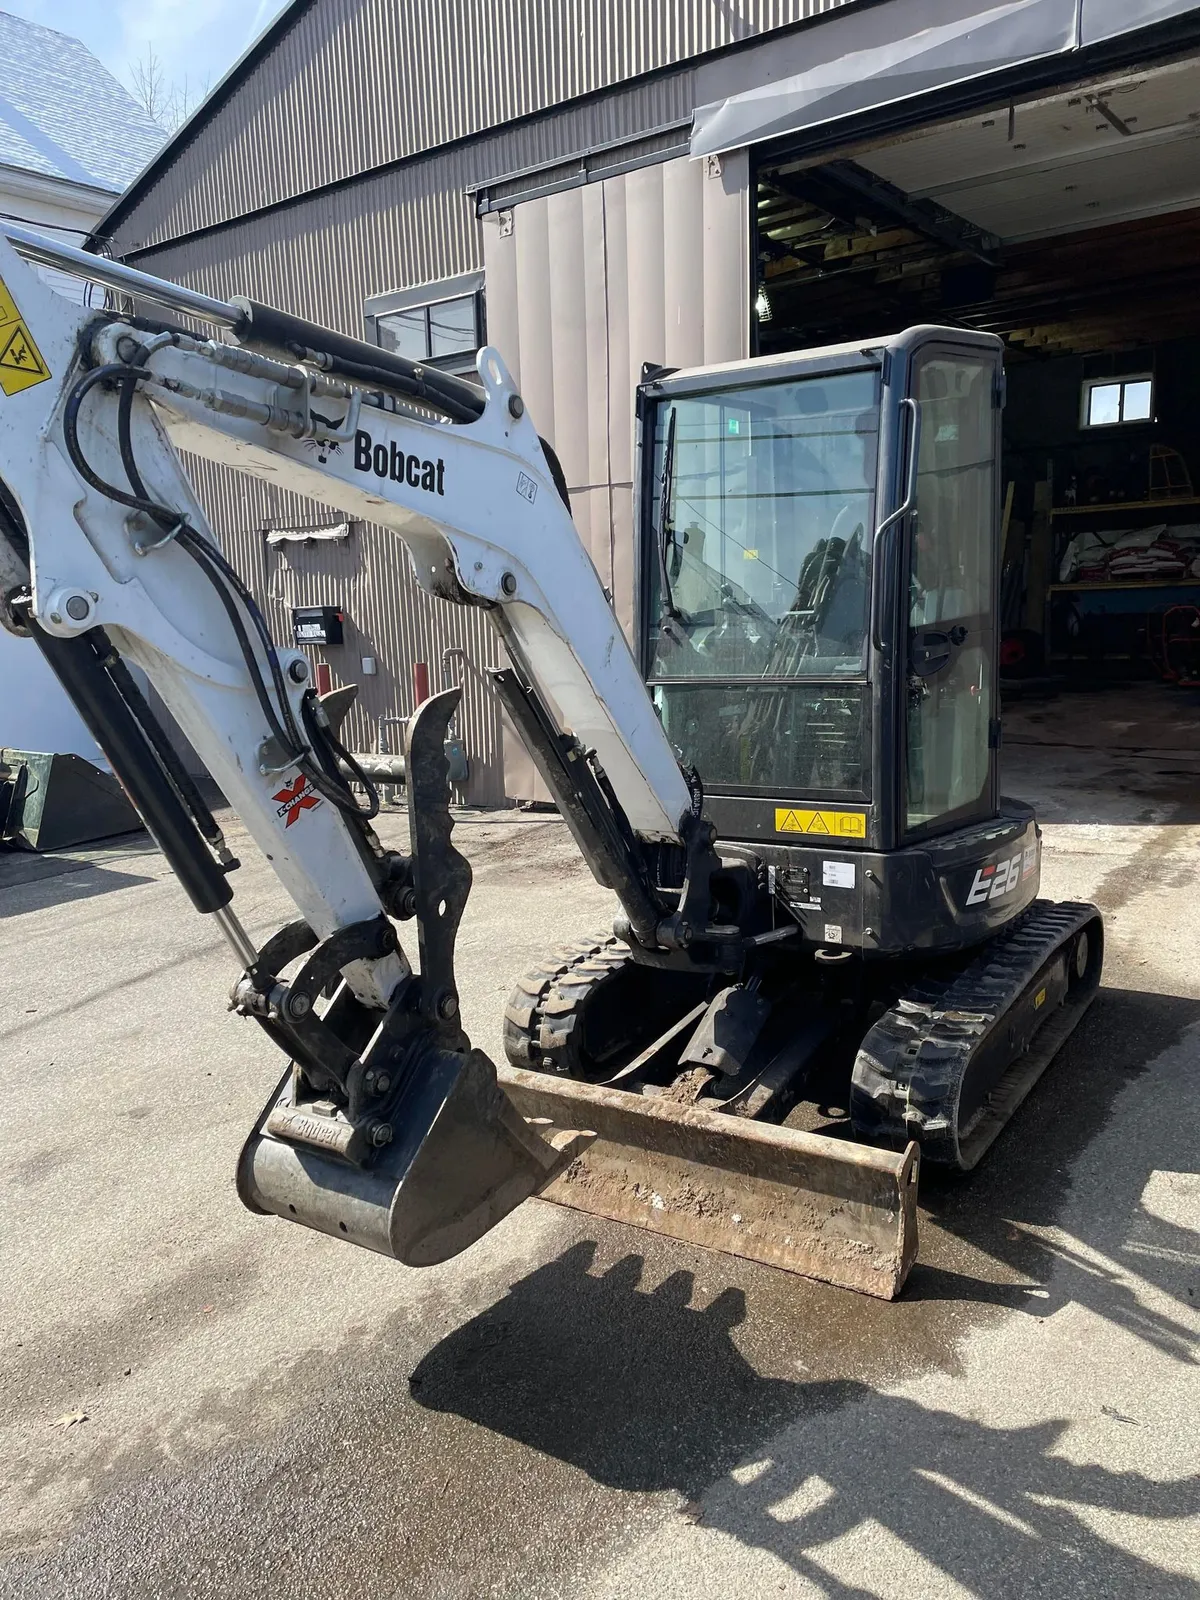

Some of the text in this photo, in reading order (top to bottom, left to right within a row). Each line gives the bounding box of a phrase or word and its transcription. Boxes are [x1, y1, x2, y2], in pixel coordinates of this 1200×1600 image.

[354, 429, 445, 496] Bobcat
[278, 784, 315, 815] X-CHANGE
[965, 853, 1022, 906] E26
[297, 1119, 342, 1147] Bobcat
